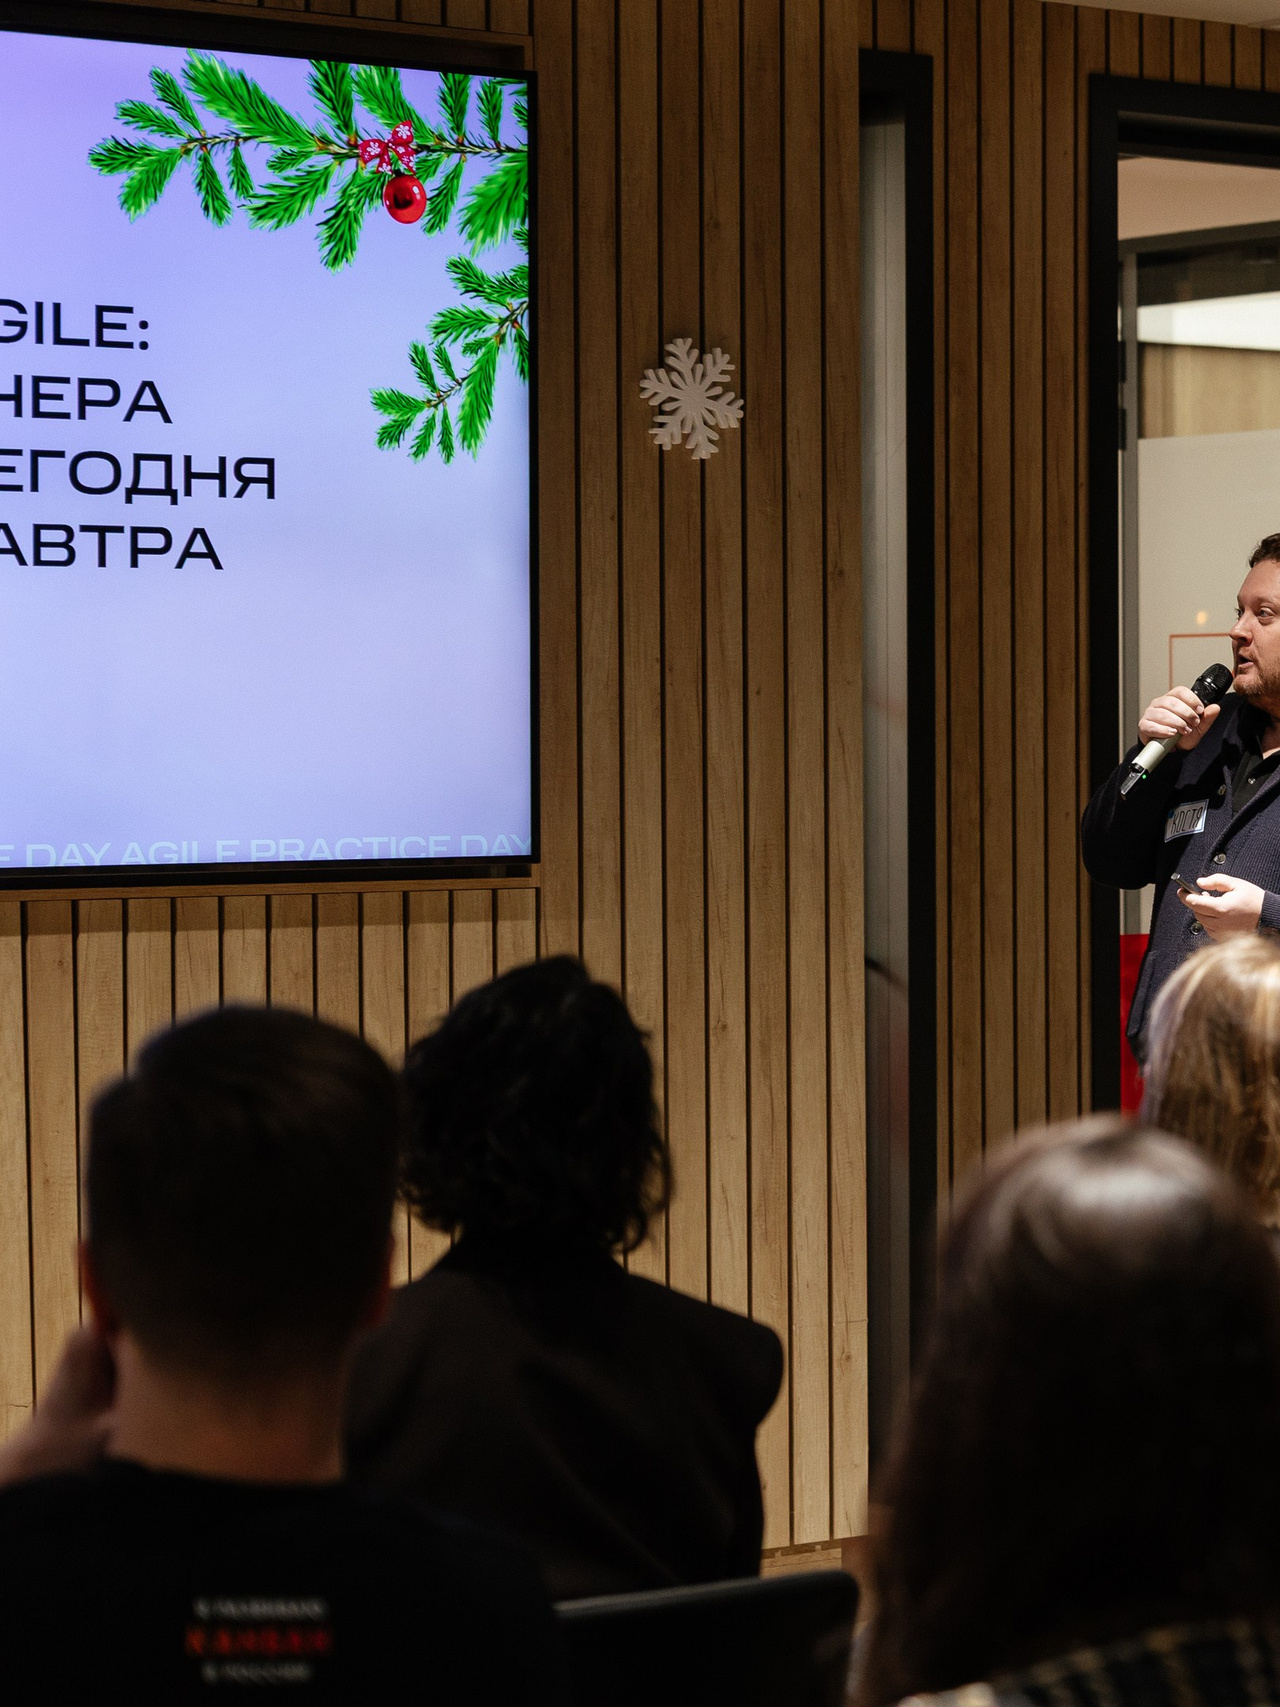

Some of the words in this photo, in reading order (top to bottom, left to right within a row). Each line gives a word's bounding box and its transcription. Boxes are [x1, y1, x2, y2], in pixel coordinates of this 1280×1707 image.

[1170, 806, 1204, 835] КОСТЯ
[26, 842, 112, 867] DAY
[119, 840, 240, 865] AGILE
[251, 835, 451, 862] PRACTICE
[461, 834, 531, 856] DAY
